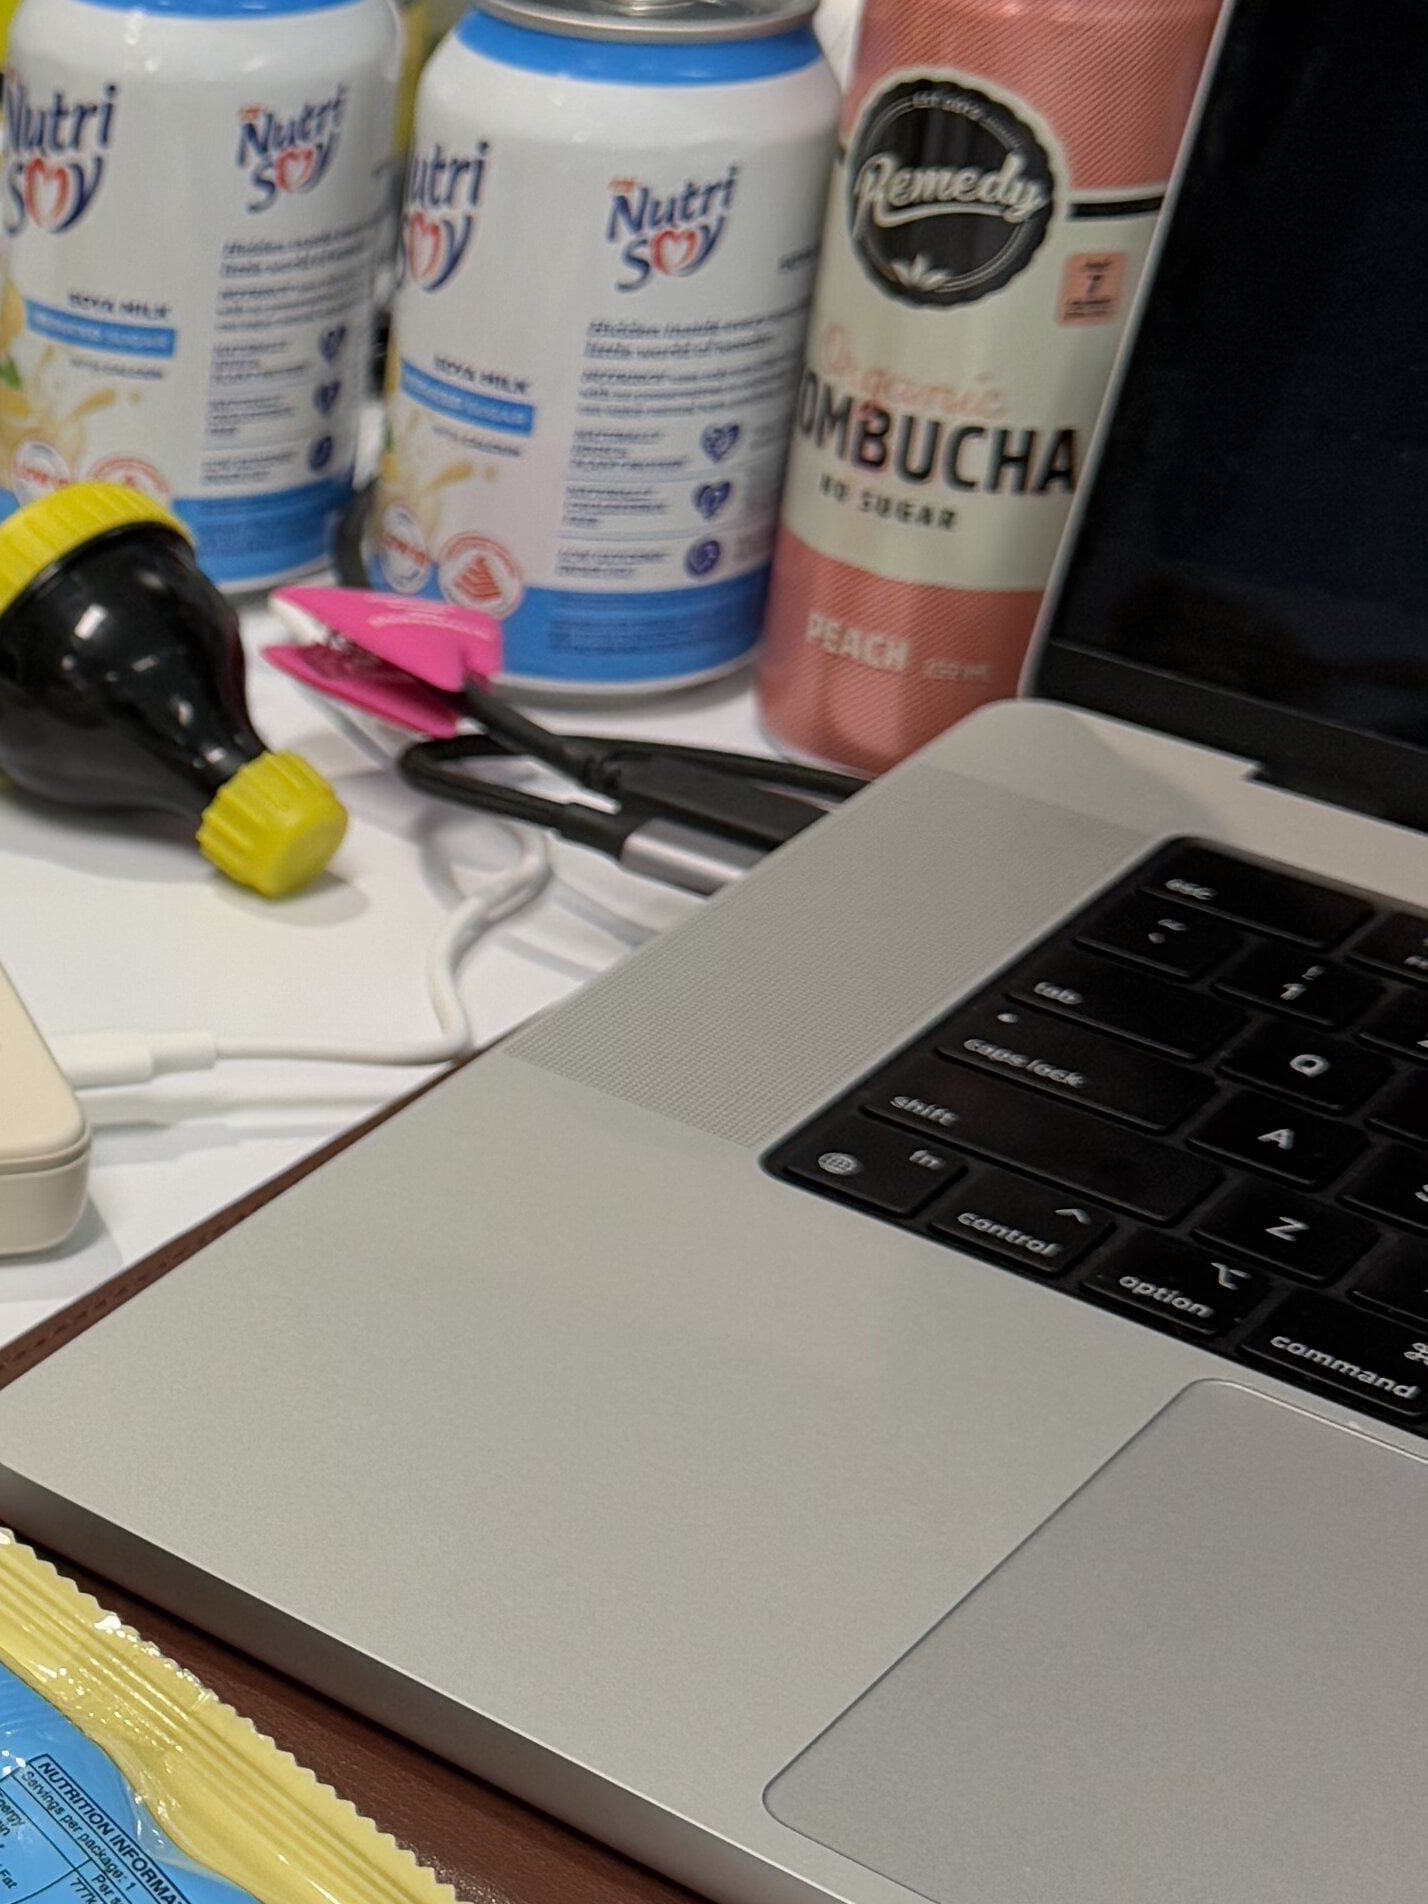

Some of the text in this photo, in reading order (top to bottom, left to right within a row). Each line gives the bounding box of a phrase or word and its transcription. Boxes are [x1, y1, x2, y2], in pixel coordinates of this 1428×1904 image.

[235, 86, 349, 169] Nutri
[410, 140, 490, 210] utri
[852, 151, 1048, 241] Remedy
[606, 165, 742, 245] Nutri
[797, 369, 1080, 496] OMBUCHA
[861, 490, 958, 531] SUGAR
[806, 610, 912, 673] PEACH
[1033, 981, 1083, 1005] tab
[963, 1038, 1088, 1088] caps lock
[1289, 1053, 1331, 1079] Q
[890, 1095, 961, 1127] shift
[909, 1149, 946, 1171] fn
[1256, 1128, 1295, 1151] A
[957, 1211, 1064, 1258] control
[1264, 1215, 1312, 1242] Z
[1118, 1271, 1216, 1319] option
[1269, 1335, 1422, 1400] command
[38, 1762, 115, 1836] NUTRITION
[21, 1771, 128, 1883] Servings per package:
[91, 1874, 114, 1896] Per
